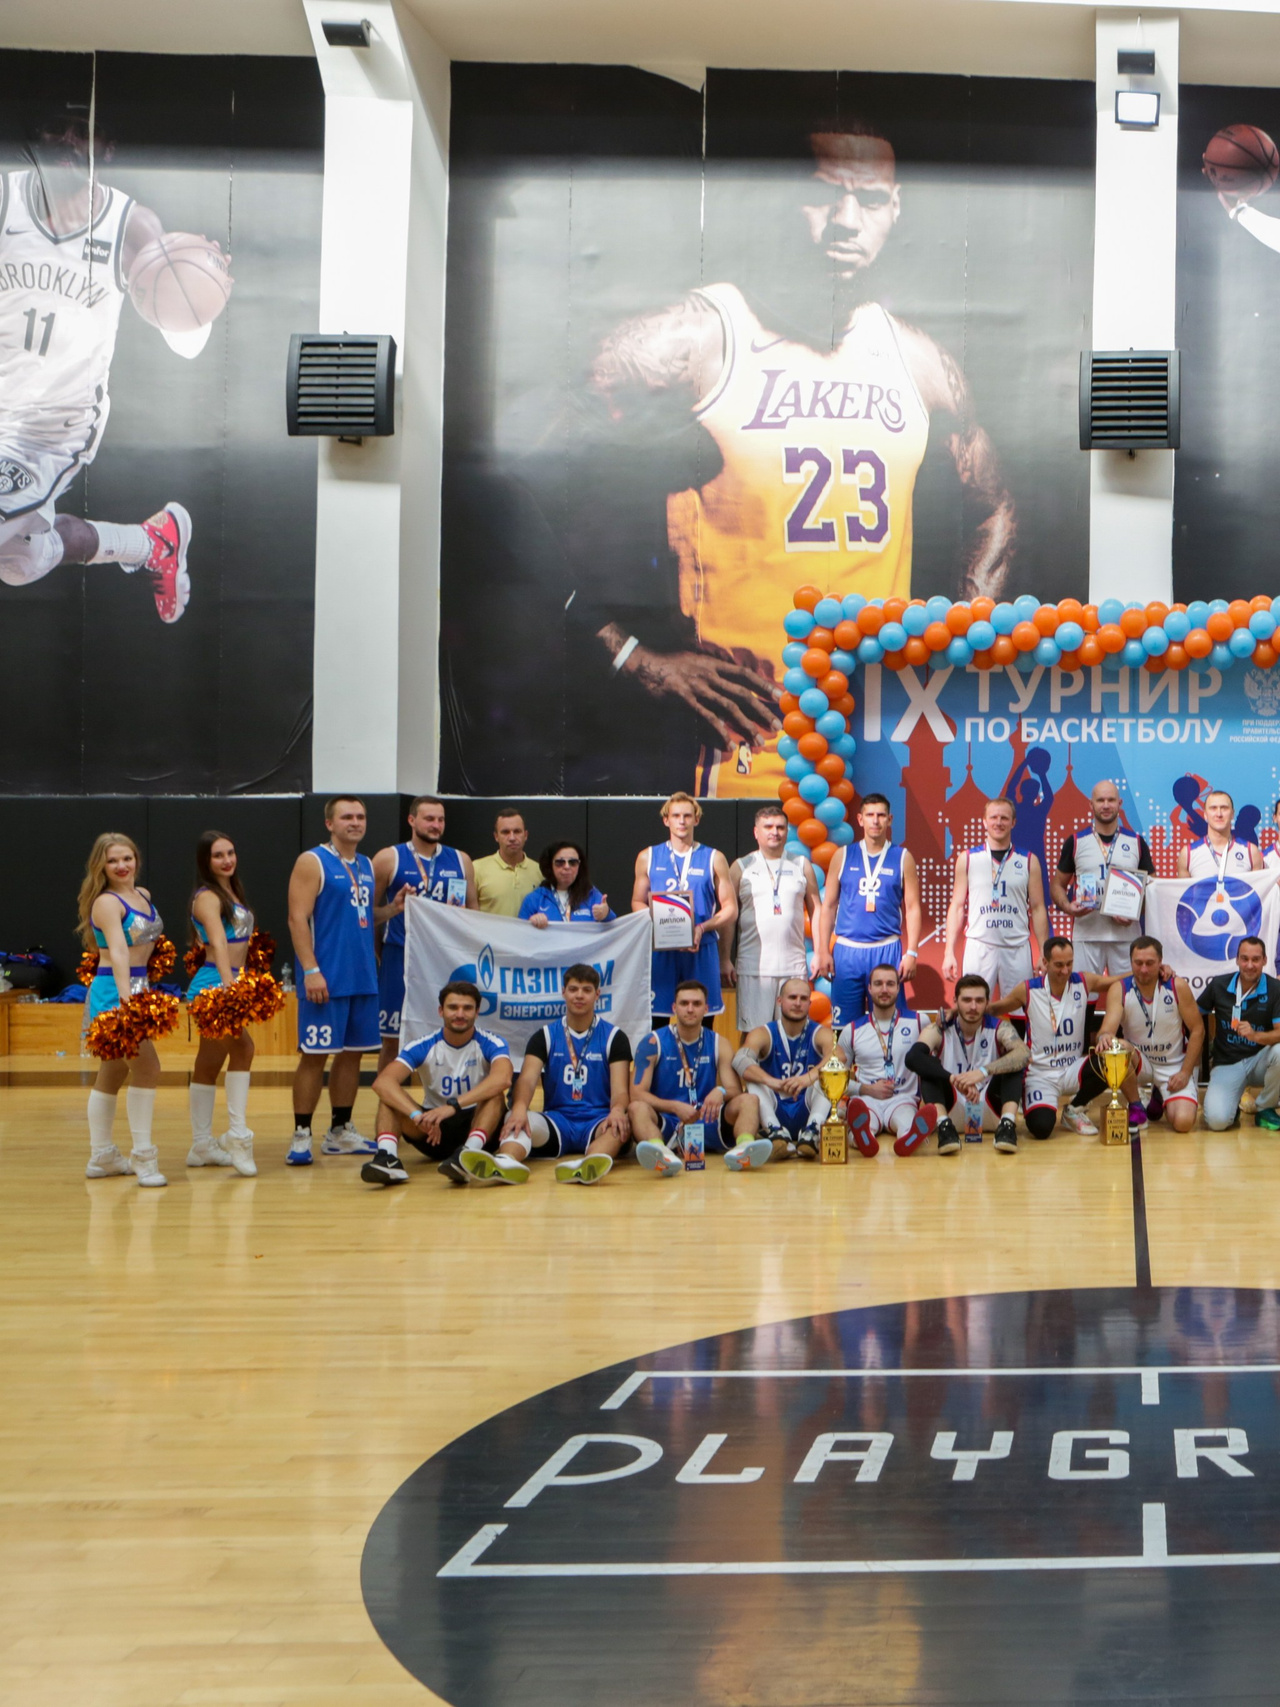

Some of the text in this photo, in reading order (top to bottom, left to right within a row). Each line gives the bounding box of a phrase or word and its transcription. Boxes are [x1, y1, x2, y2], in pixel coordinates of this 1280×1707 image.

[23, 306, 56, 357] 11
[741, 368, 907, 434] LAKERS
[782, 445, 891, 552] 23
[965, 663, 1223, 714] ТУРНИР
[862, 662, 956, 743] IX
[964, 717, 1223, 744] ПО БАСКЕТБОЛУ
[1229, 735, 1269, 743] РОССИЙСКОЙ
[350, 886, 370, 907] 33
[858, 877, 881, 897] 92
[1000, 880, 1008, 897] 1
[658, 917, 685, 925] ДИПЛОМ
[986, 919, 1014, 929] САРОВ
[499, 960, 615, 994] ГАЗПМ
[503, 996, 609, 1018] ЭНЕРГОХОНГ
[379, 1010, 401, 1031] 24
[306, 1025, 332, 1046] 33
[563, 1063, 588, 1085] 69
[441, 1075, 471, 1096] 911
[1026, 1090, 1043, 1106] 10
